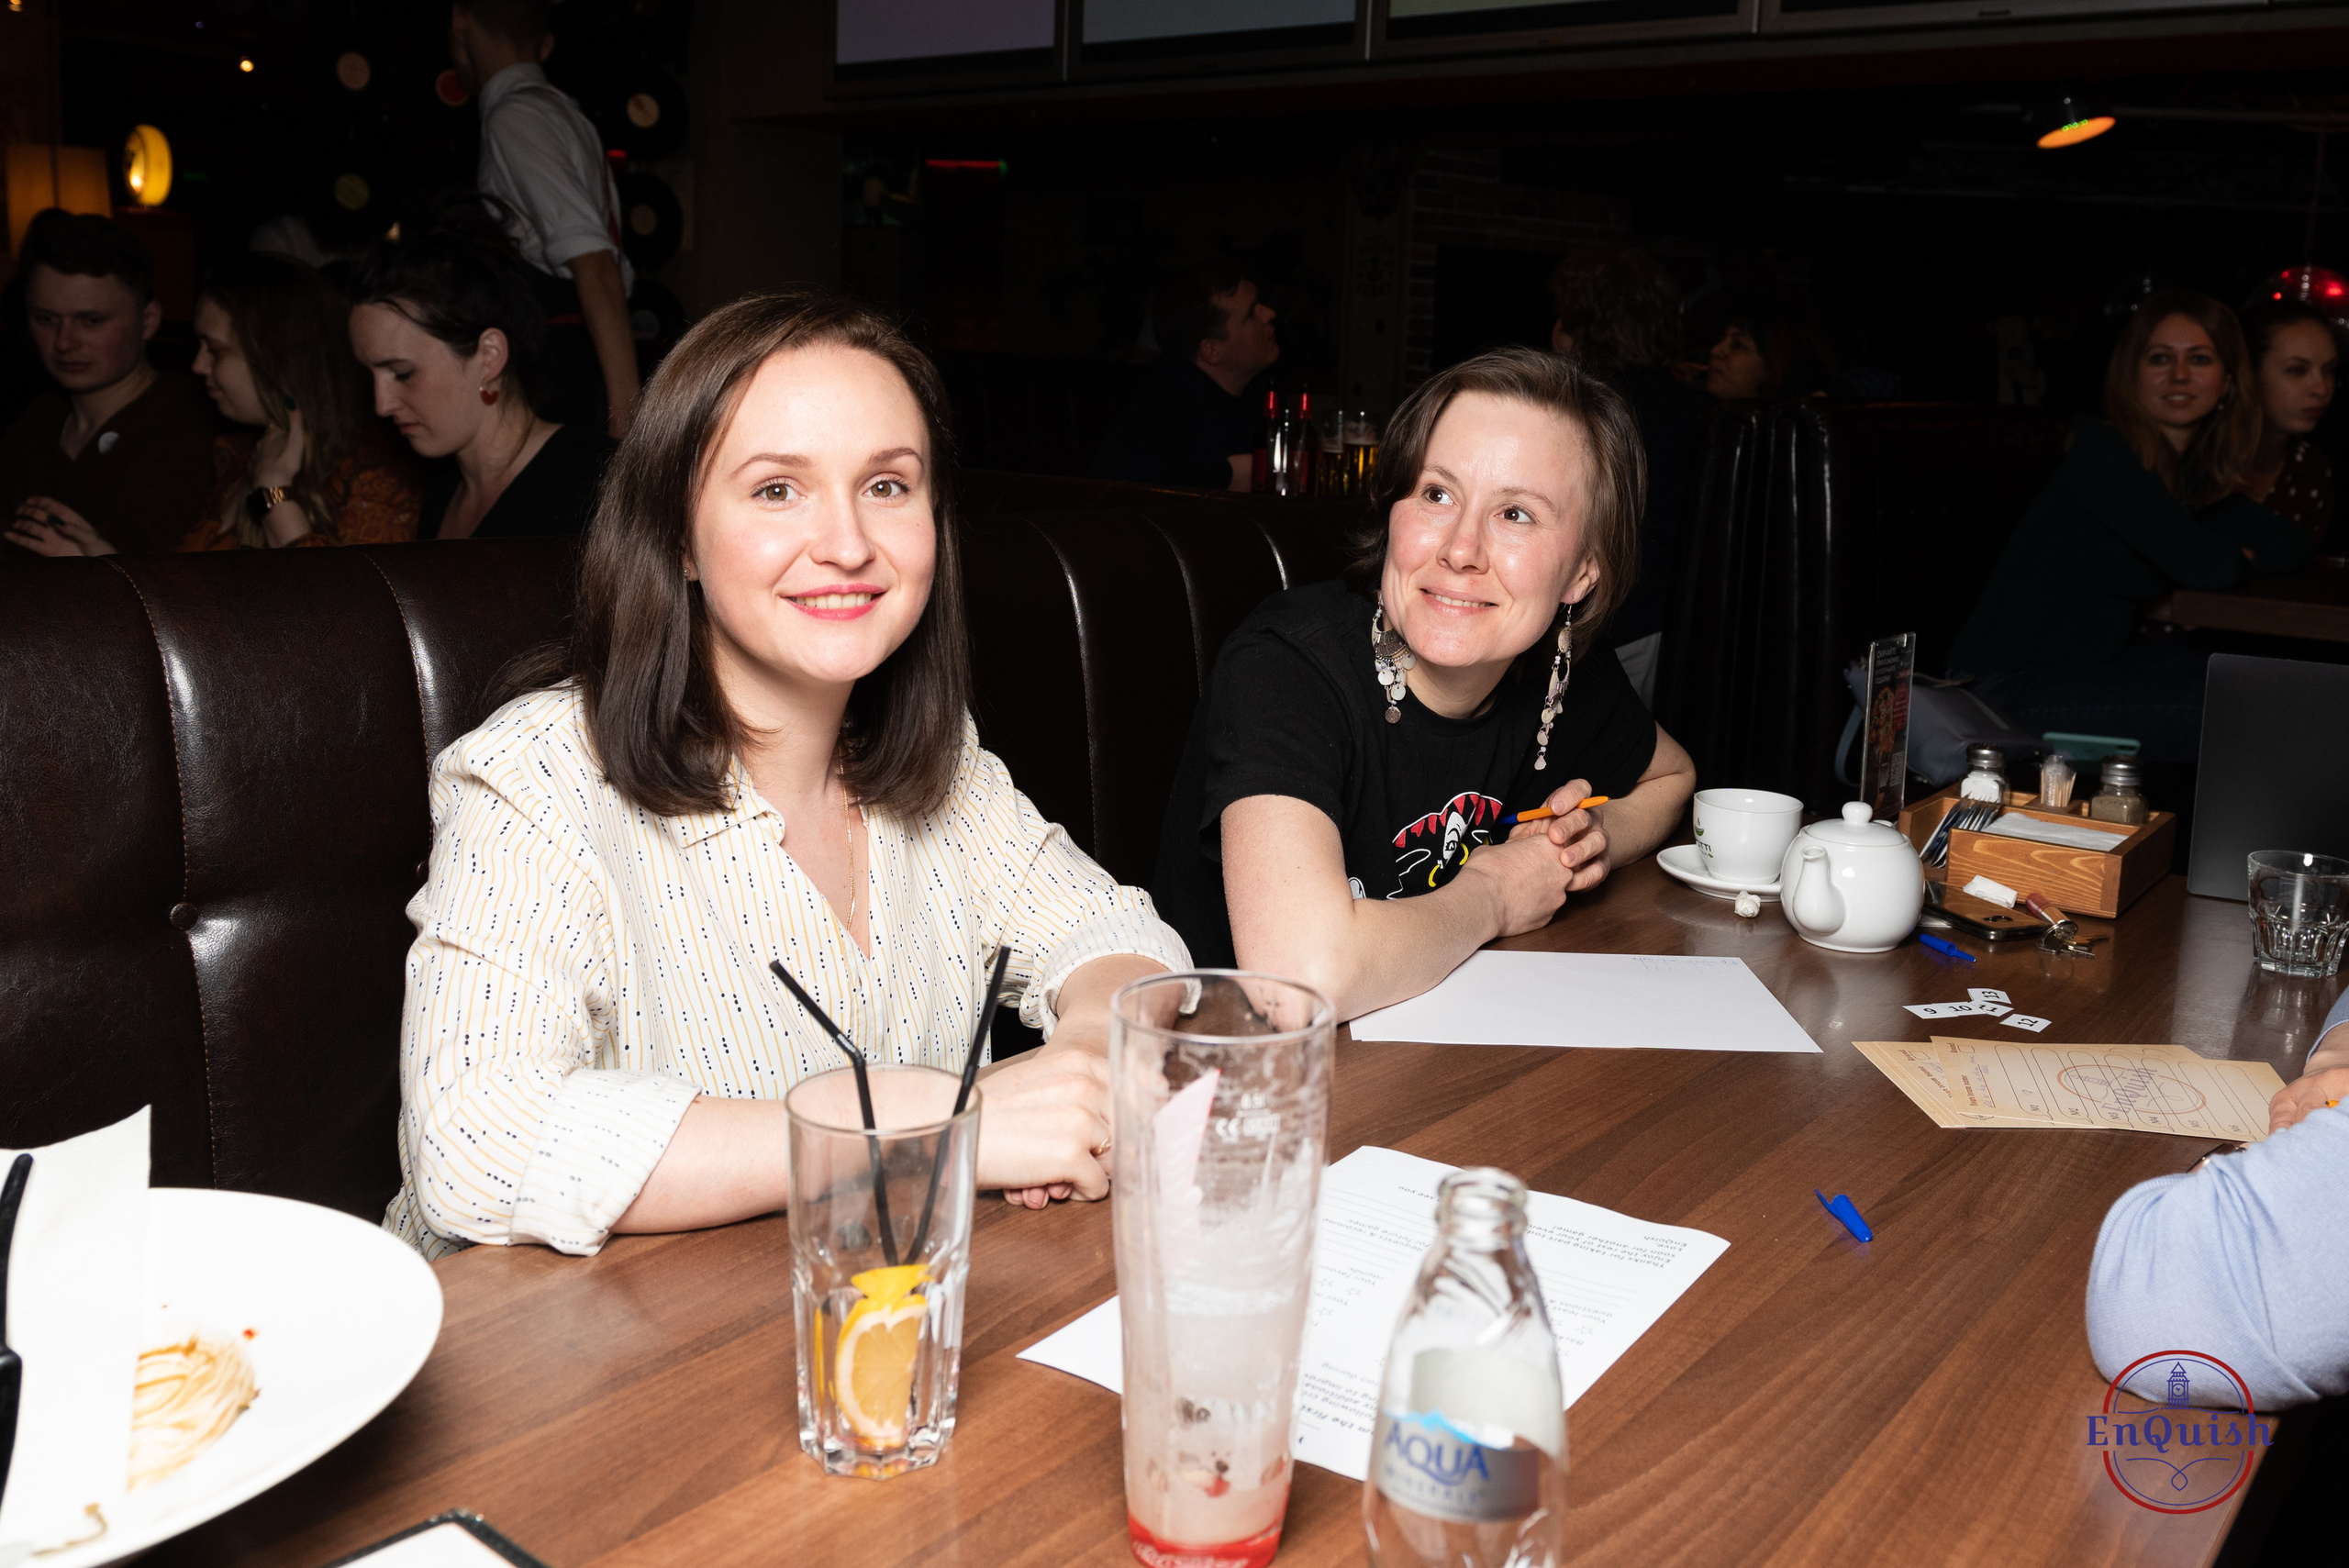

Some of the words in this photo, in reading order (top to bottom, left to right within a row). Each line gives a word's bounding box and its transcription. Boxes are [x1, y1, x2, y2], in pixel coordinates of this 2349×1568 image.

[1982, 991, 2000, 999] 13
[2017, 1018, 2039, 1027] 12
[1381, 1229, 1413, 1243] future
[1549, 1235, 1572, 1246] part
[1555, 1232, 1580, 1242] your
[1643, 1235, 1687, 1248] EnQuish
[1379, 1235, 1423, 1252] Requests
[1586, 1235, 1629, 1249] another
[1573, 1242, 1607, 1256] taking
[1597, 1243, 1619, 1253] rest
[1620, 1249, 1639, 1257] the
[1631, 1245, 1648, 1254] for
[1609, 1252, 1625, 1261] for
[1641, 1253, 1672, 1264] Enjoy
[1650, 1249, 1676, 1259] soon
[1629, 1257, 1664, 1269] Thanks
[1386, 1421, 1489, 1486] AQUA
